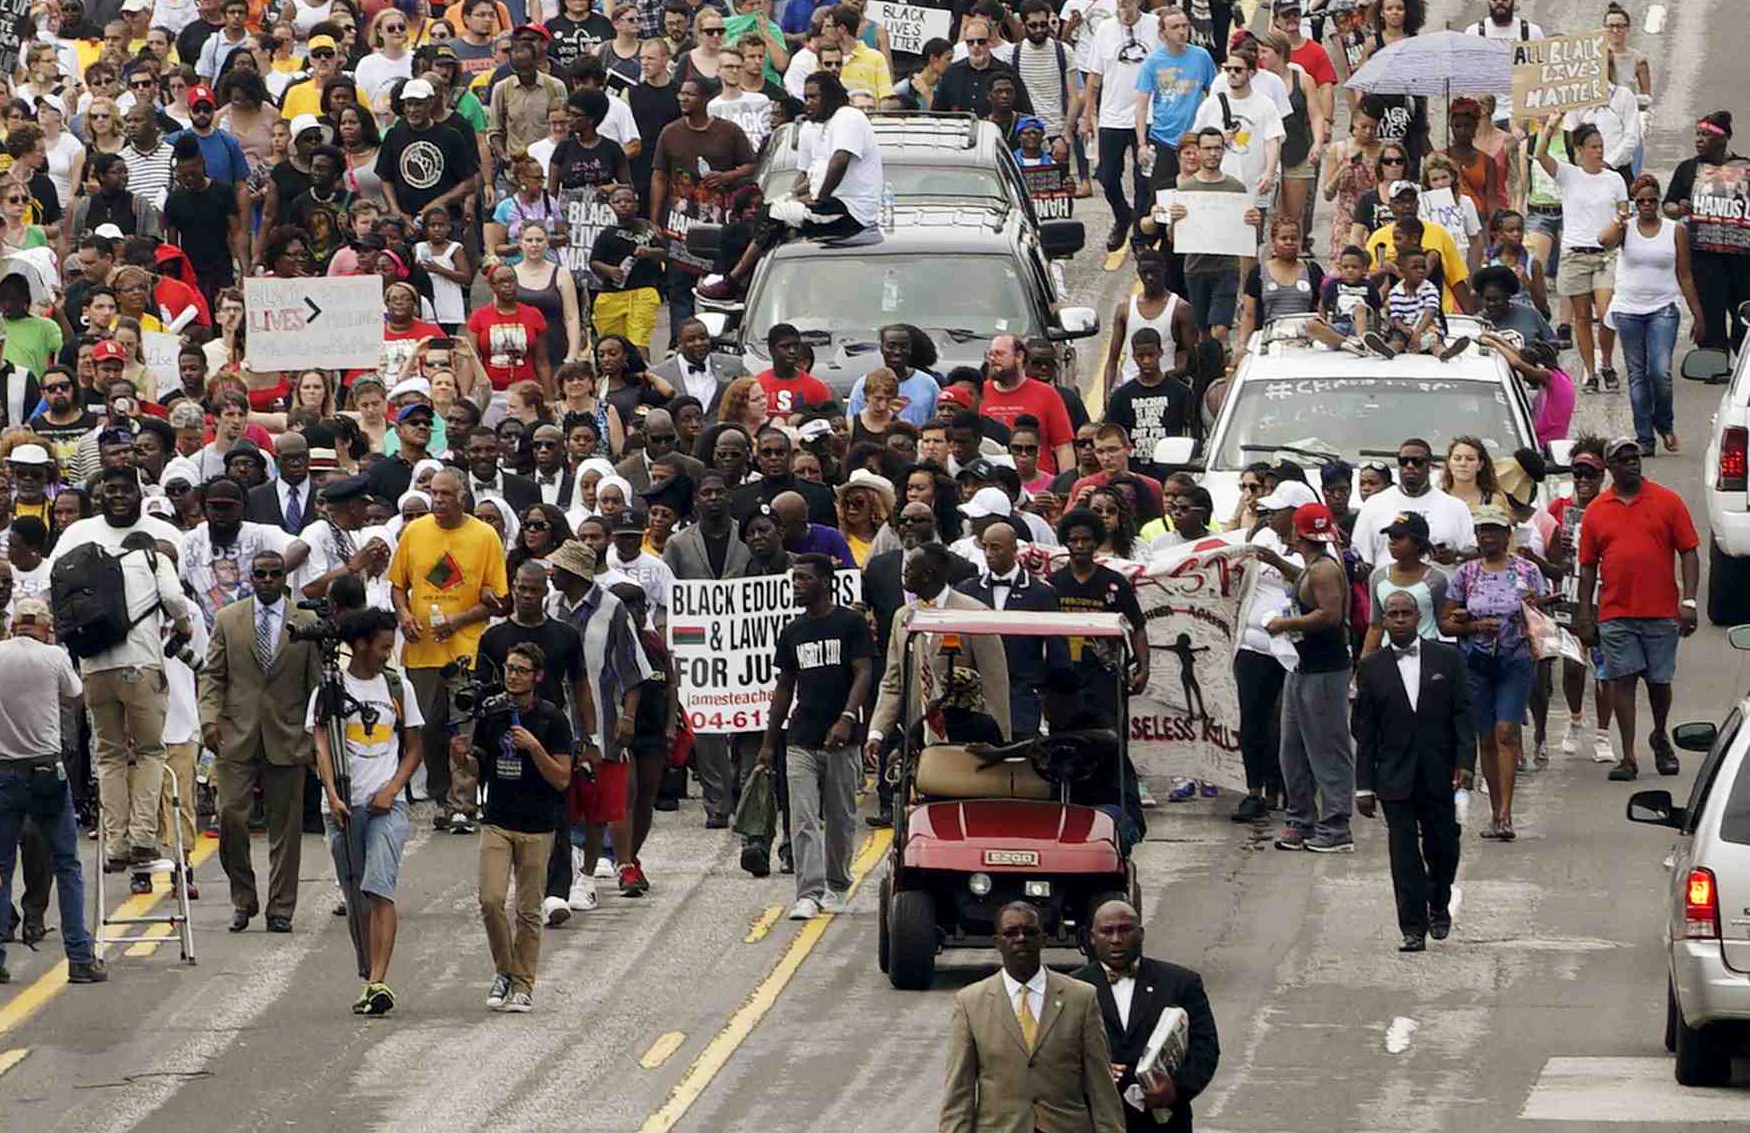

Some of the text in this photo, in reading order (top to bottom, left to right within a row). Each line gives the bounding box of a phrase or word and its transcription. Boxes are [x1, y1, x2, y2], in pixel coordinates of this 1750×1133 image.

[882, 4, 927, 25] BLACK
[891, 34, 922, 53] TTER
[1513, 35, 1605, 66] ALL BLACK
[1541, 57, 1601, 82] LIVES
[1524, 76, 1605, 108] MATTER
[1693, 195, 1741, 218] HANDS
[562, 248, 592, 271] MAT
[250, 307, 305, 332] LIVES
[673, 570, 854, 616] BLACK EDUCRS
[709, 621, 723, 652] &
[676, 656, 729, 690] FOR
[1131, 716, 1195, 741] SELESS
